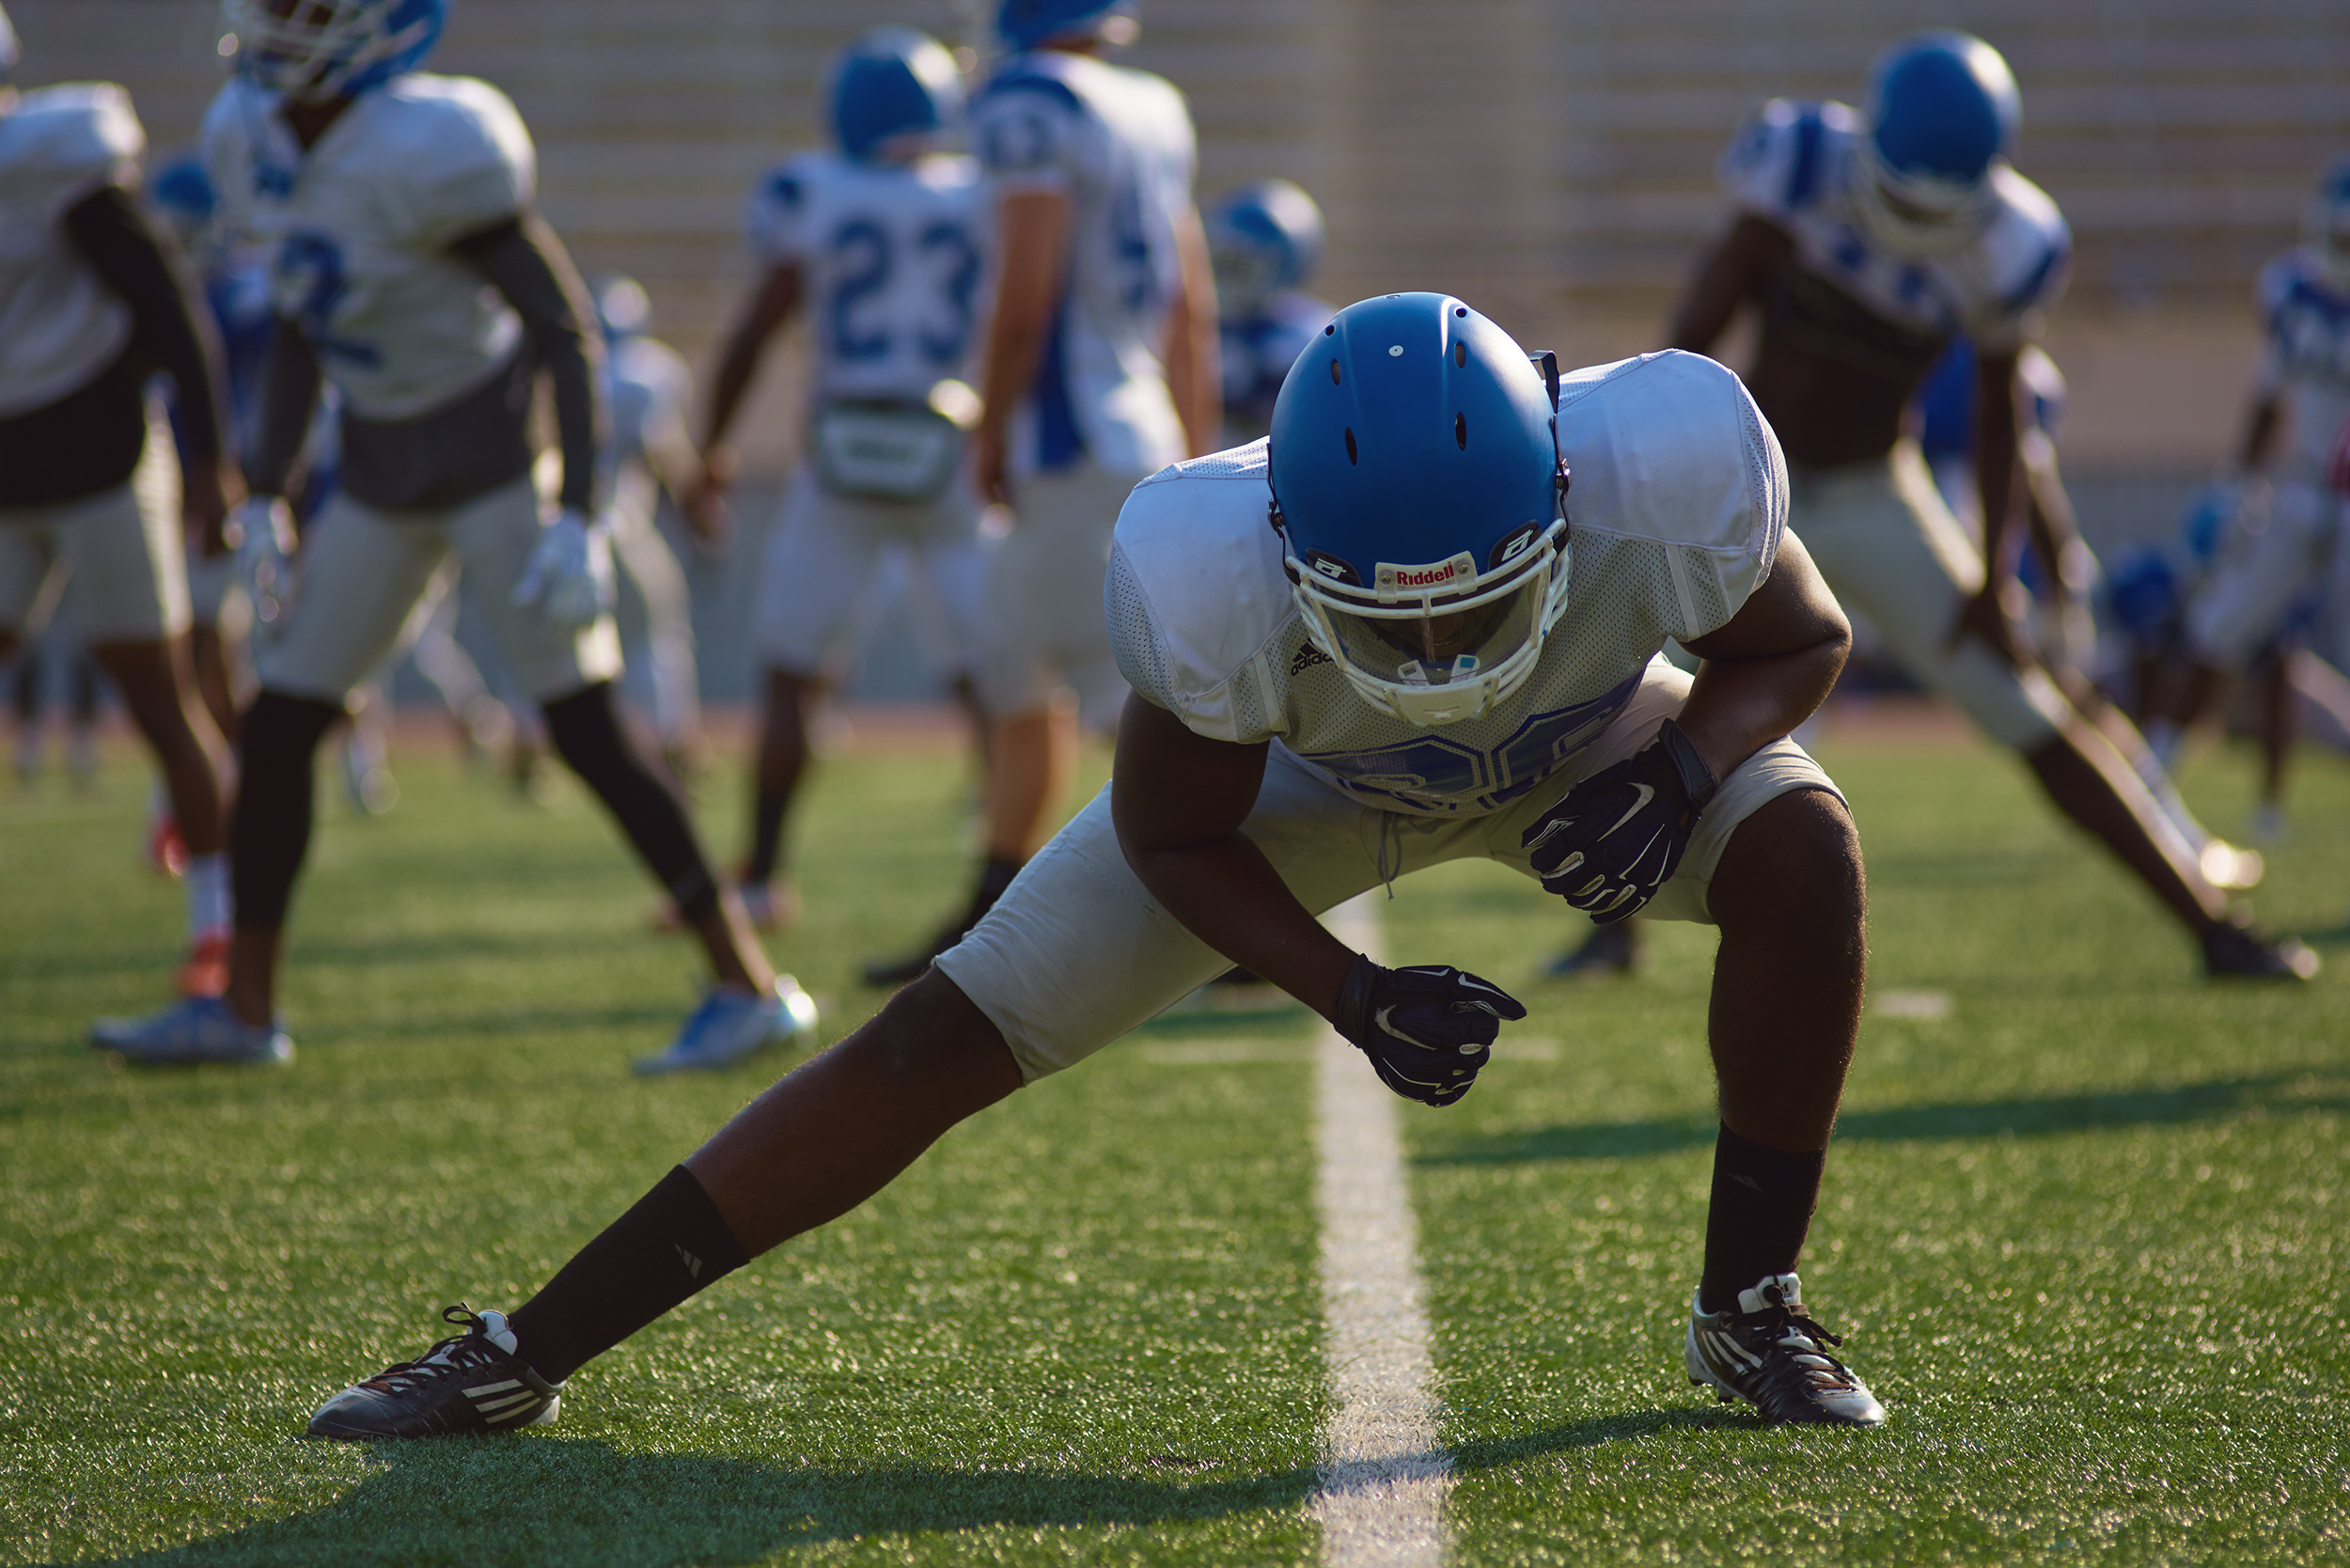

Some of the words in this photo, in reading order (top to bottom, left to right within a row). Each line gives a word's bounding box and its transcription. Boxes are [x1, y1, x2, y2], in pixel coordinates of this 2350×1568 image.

[829, 218, 980, 368] 23
[1396, 561, 1455, 586] Riddell
[1291, 652, 1333, 677] adida
